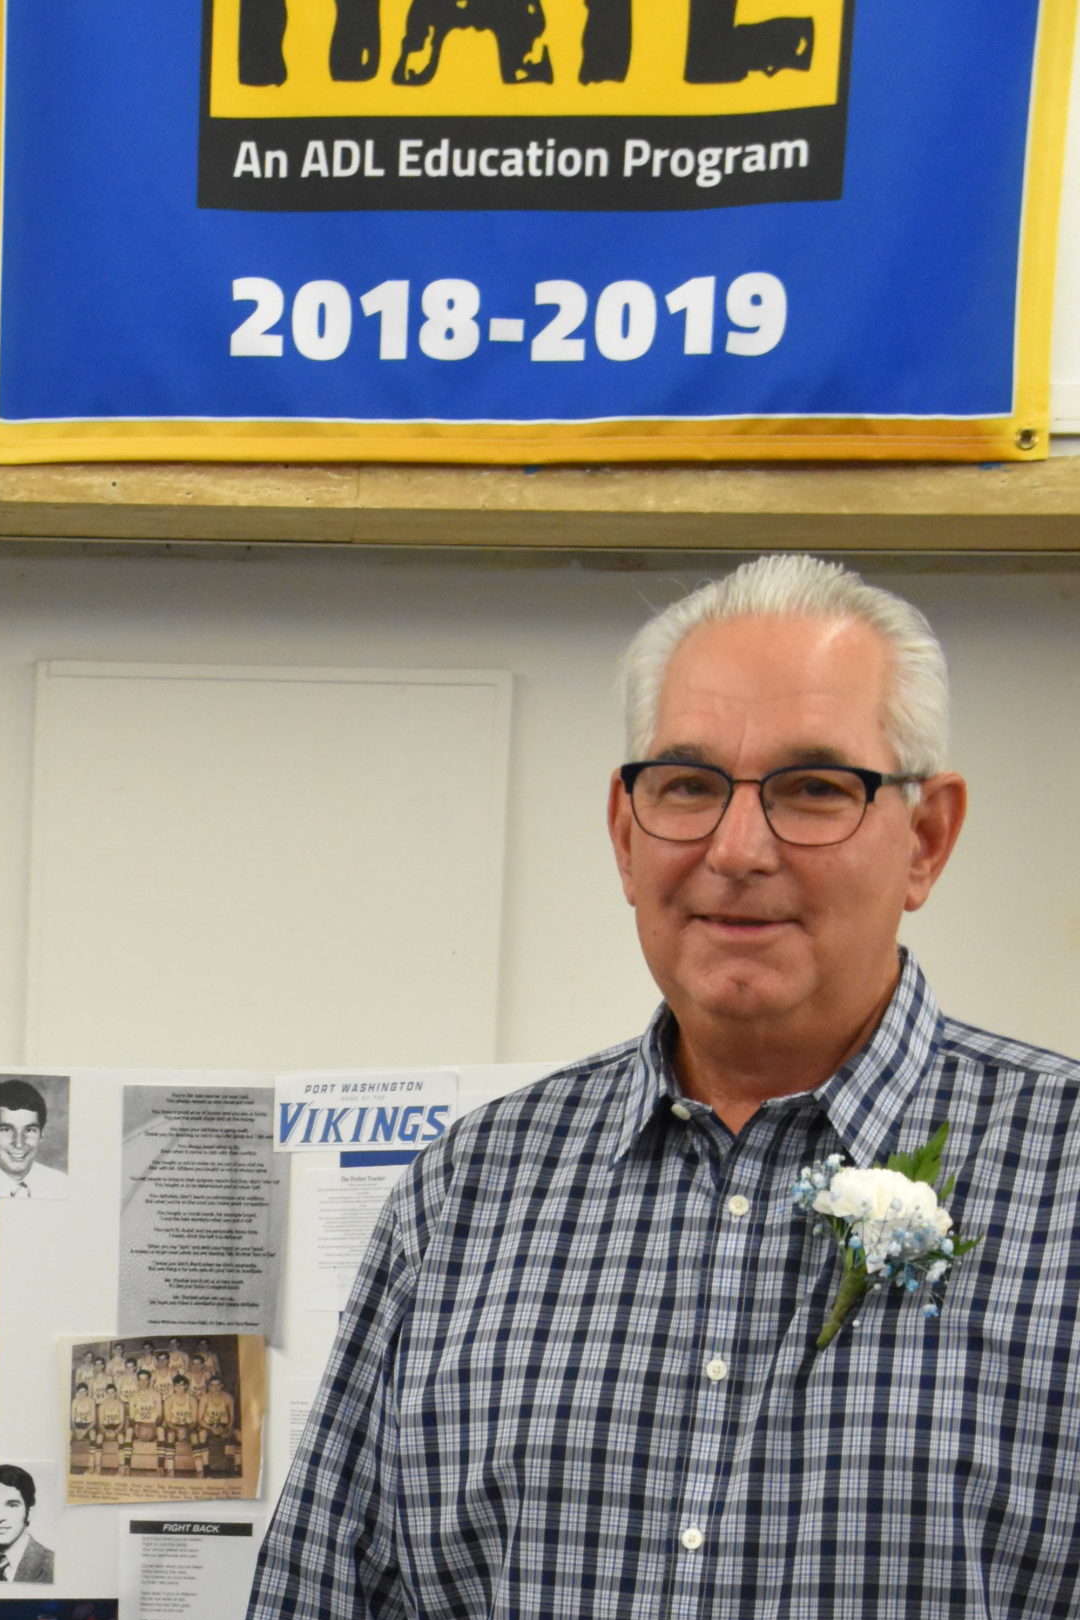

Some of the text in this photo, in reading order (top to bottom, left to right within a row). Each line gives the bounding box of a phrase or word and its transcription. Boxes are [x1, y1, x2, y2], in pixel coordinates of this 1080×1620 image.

[233, 136, 809, 187] An ADL Education Program
[229, 271, 788, 362] 2018-2019
[304, 1081, 424, 1095] PORT WASHINGTON
[279, 1101, 449, 1144] VIKINGS
[163, 1523, 220, 1533] FIGHT BACK
